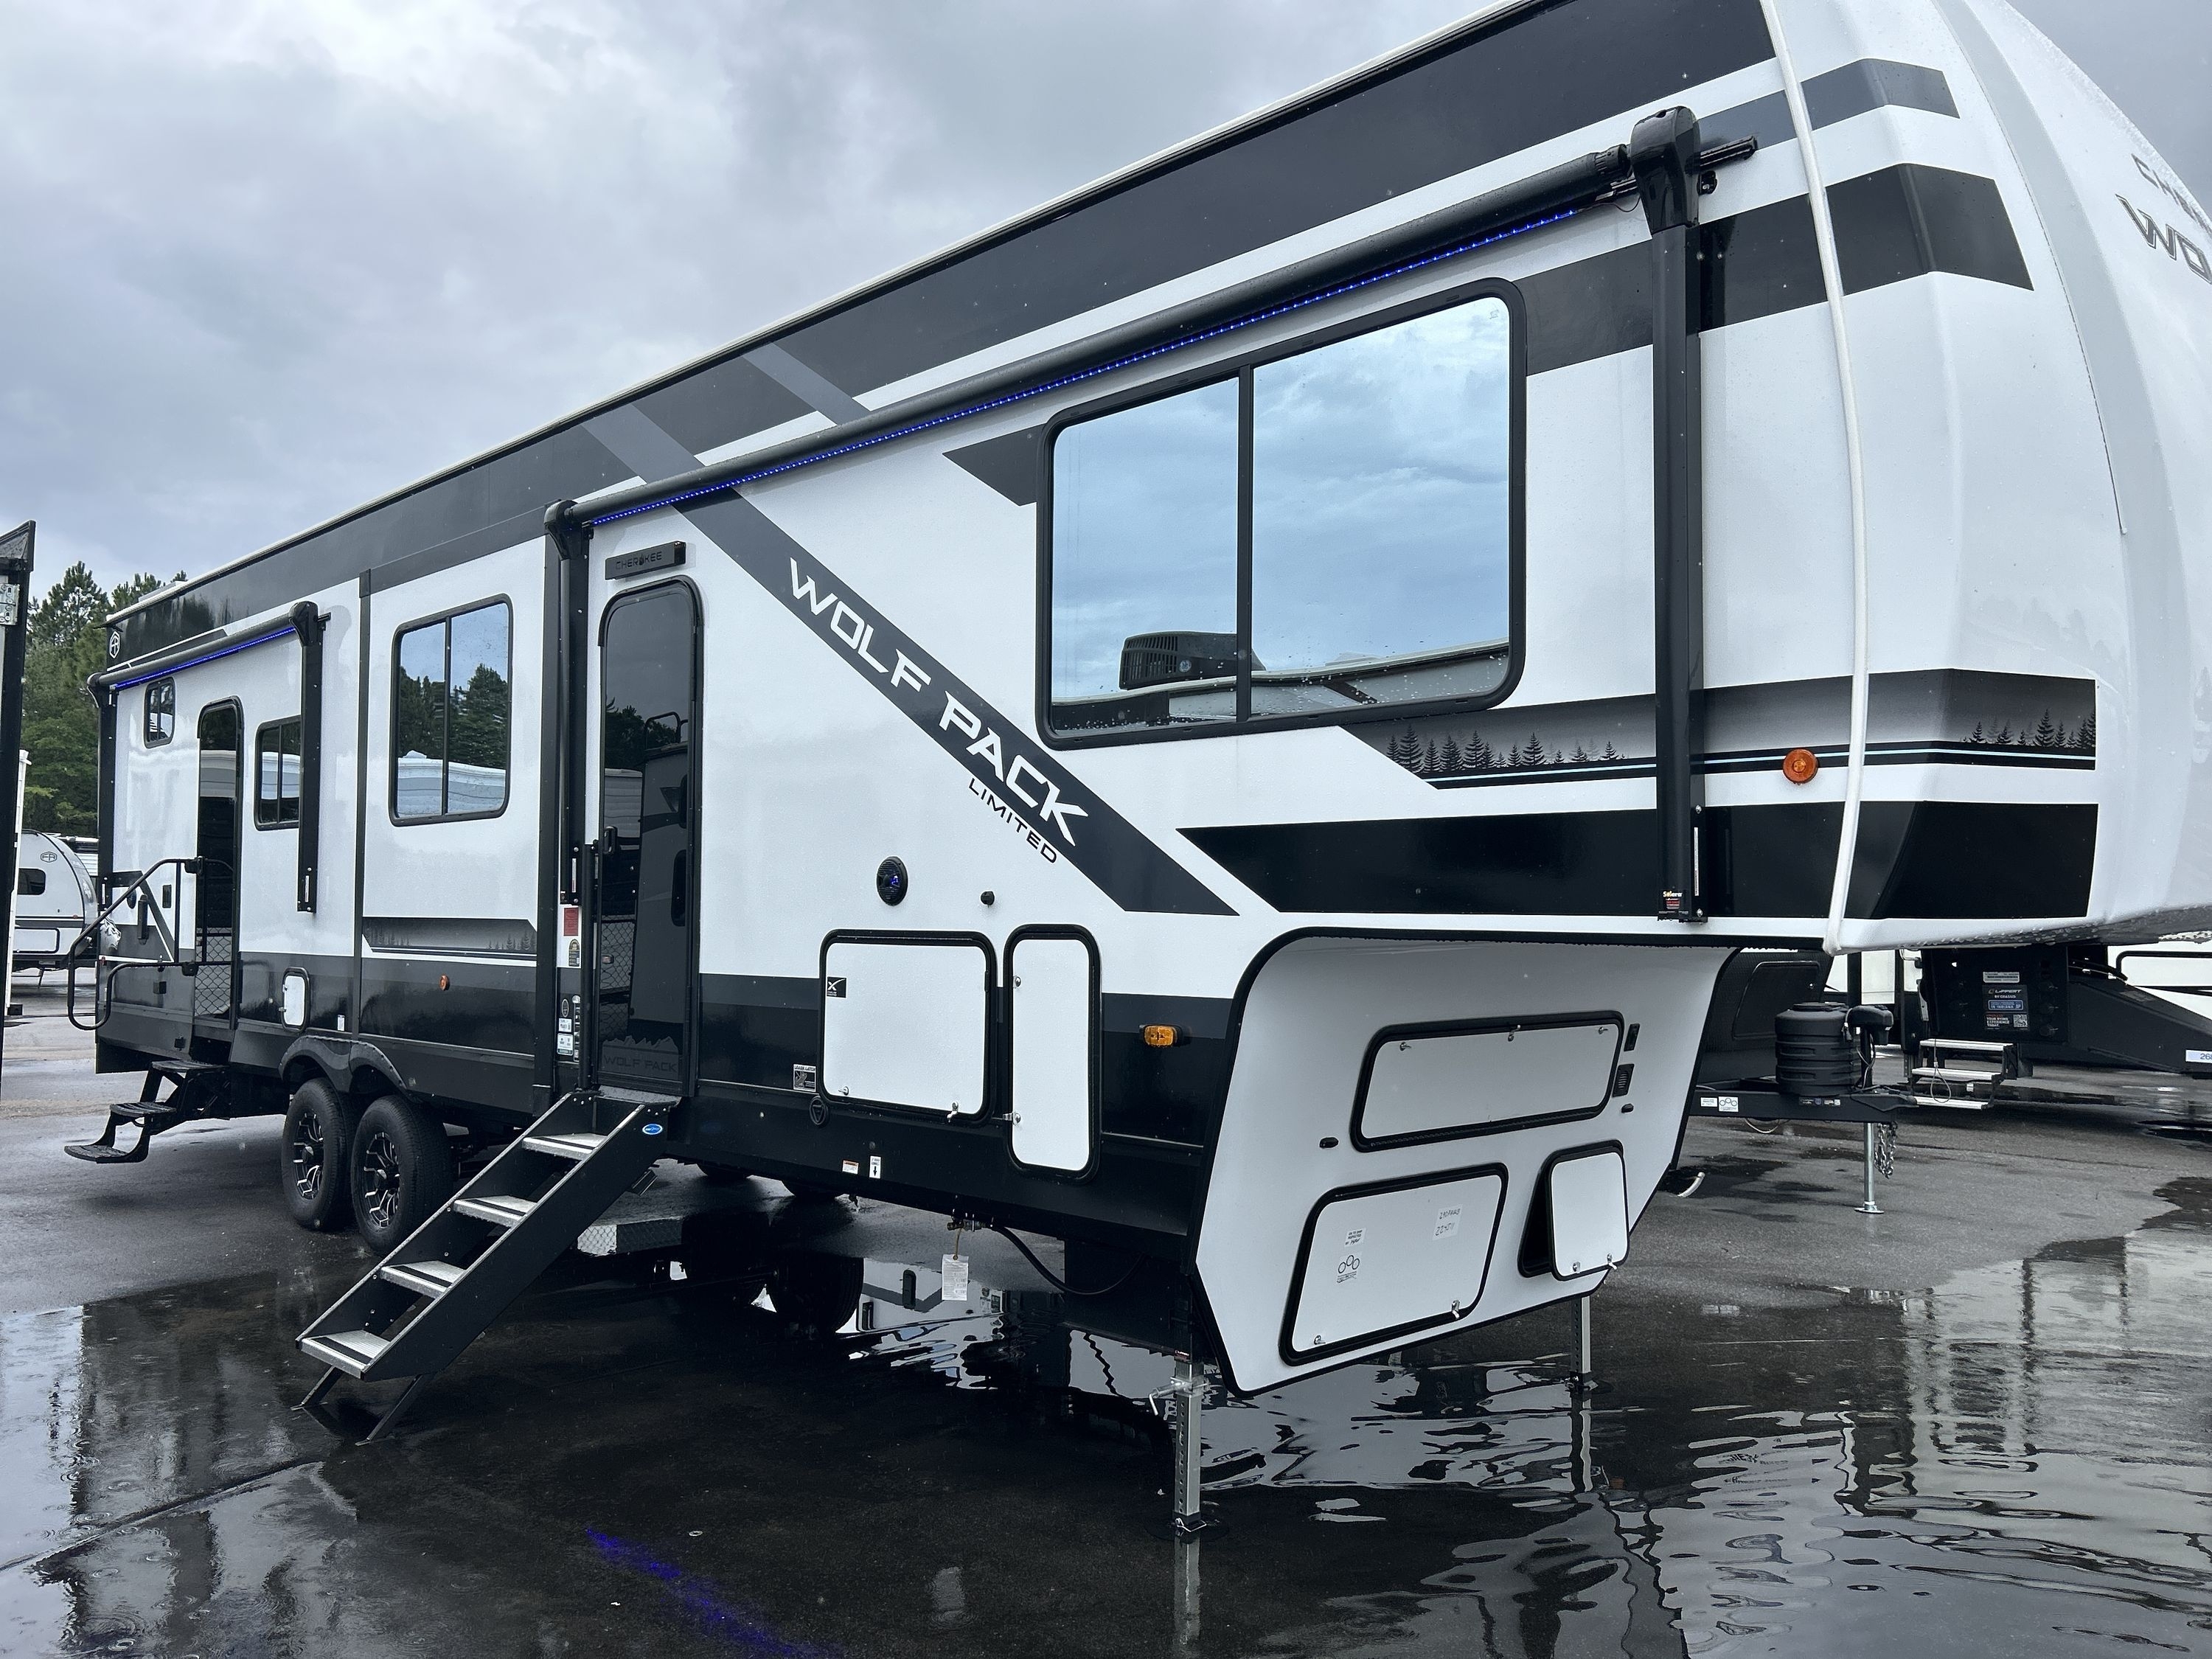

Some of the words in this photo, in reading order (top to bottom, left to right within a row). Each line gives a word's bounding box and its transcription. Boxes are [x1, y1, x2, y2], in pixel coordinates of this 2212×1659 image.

[615, 551, 662, 570] CHEROKEE
[790, 557, 932, 692] WOLF
[939, 690, 1089, 847] PACK
[968, 777, 1057, 863] LIMITED
